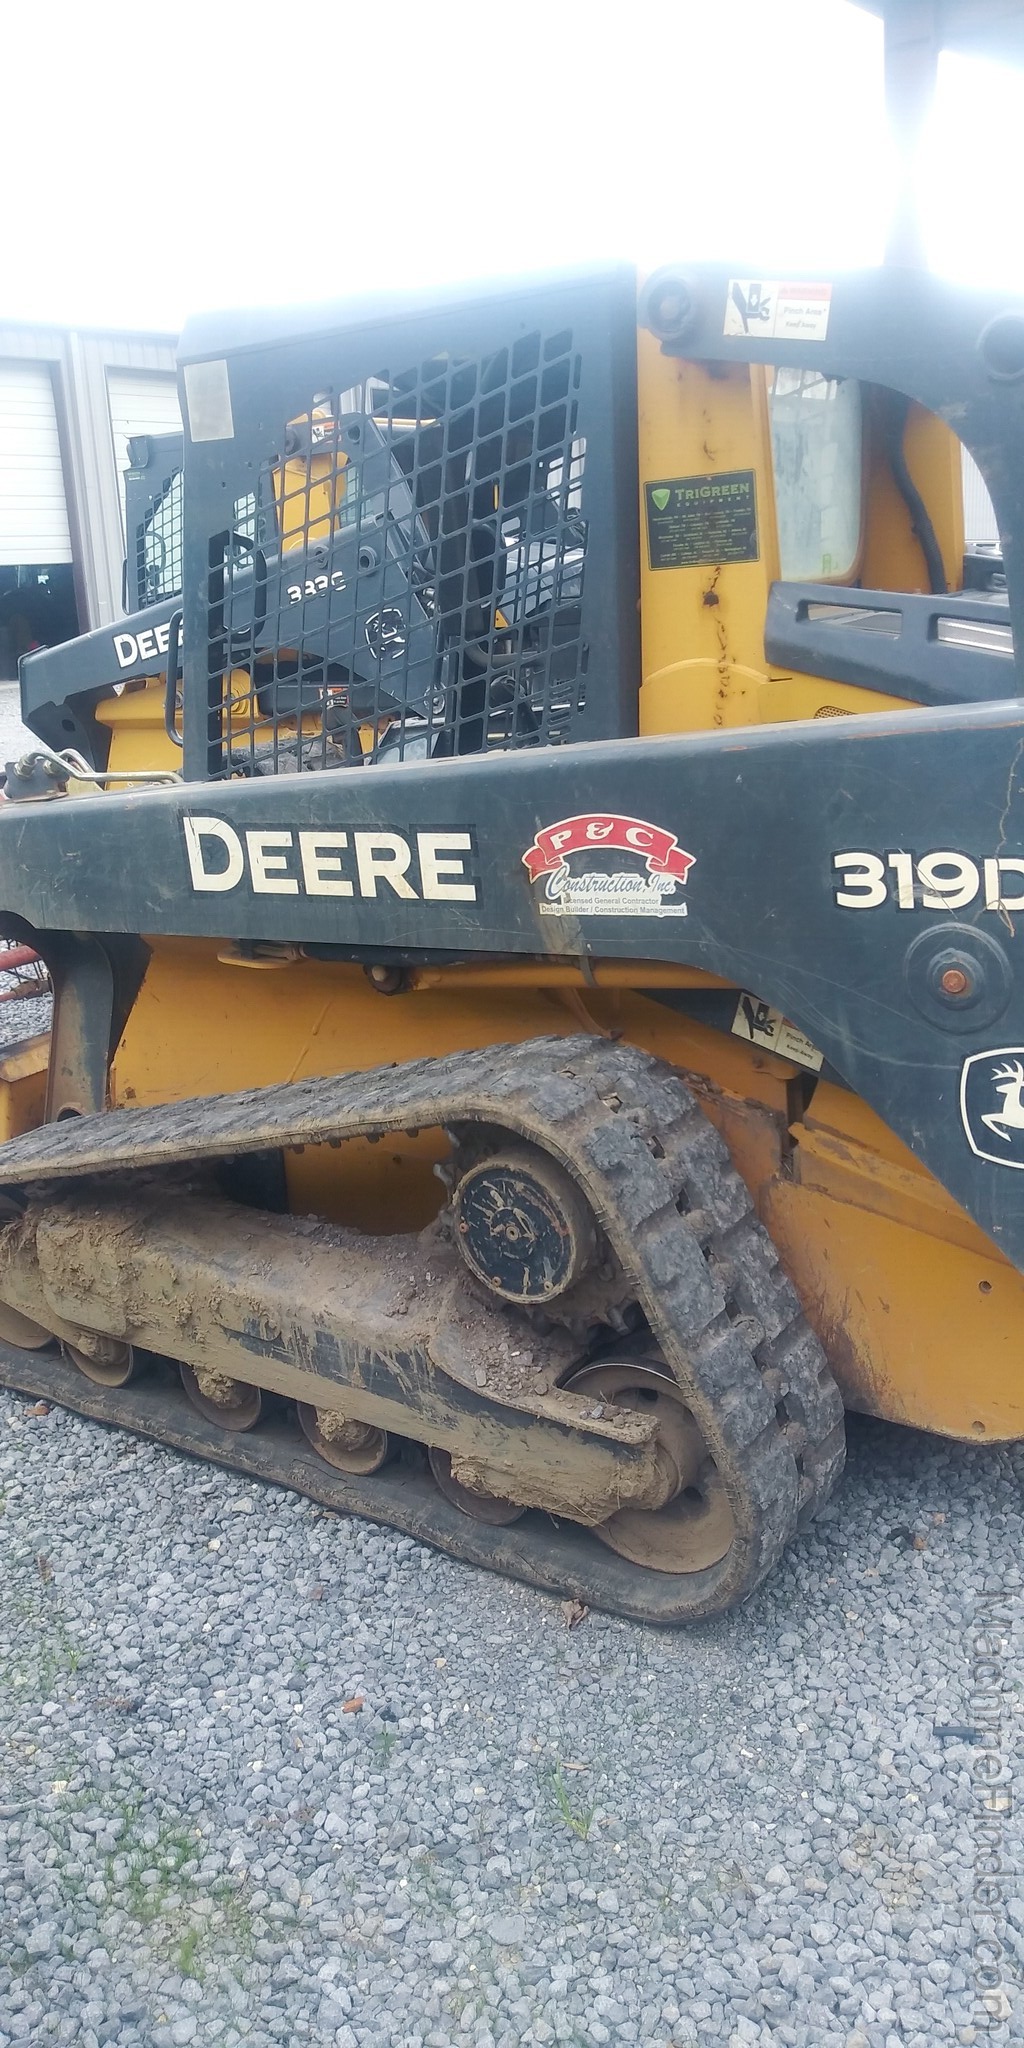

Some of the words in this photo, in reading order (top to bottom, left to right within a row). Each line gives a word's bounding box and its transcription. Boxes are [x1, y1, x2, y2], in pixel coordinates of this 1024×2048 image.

[113, 618, 184, 668] DEE
[550, 830, 572, 850] P
[586, 822, 614, 840] &
[626, 828, 654, 847] C
[183, 817, 476, 901] DEERE
[548, 865, 646, 897] Construction,
[651, 874, 675, 893] Inc.
[834, 852, 1024, 911] 319D
[541, 905, 564, 914] Design
[566, 905, 589, 914] Builder
[594, 905, 638, 914] Construction
[639, 906, 685, 915] Management
[563, 897, 596, 905] Lcensed
[594, 897, 621, 905] General
[622, 897, 659, 905] Contractor
[786, 1032, 804, 1045] Pinch
